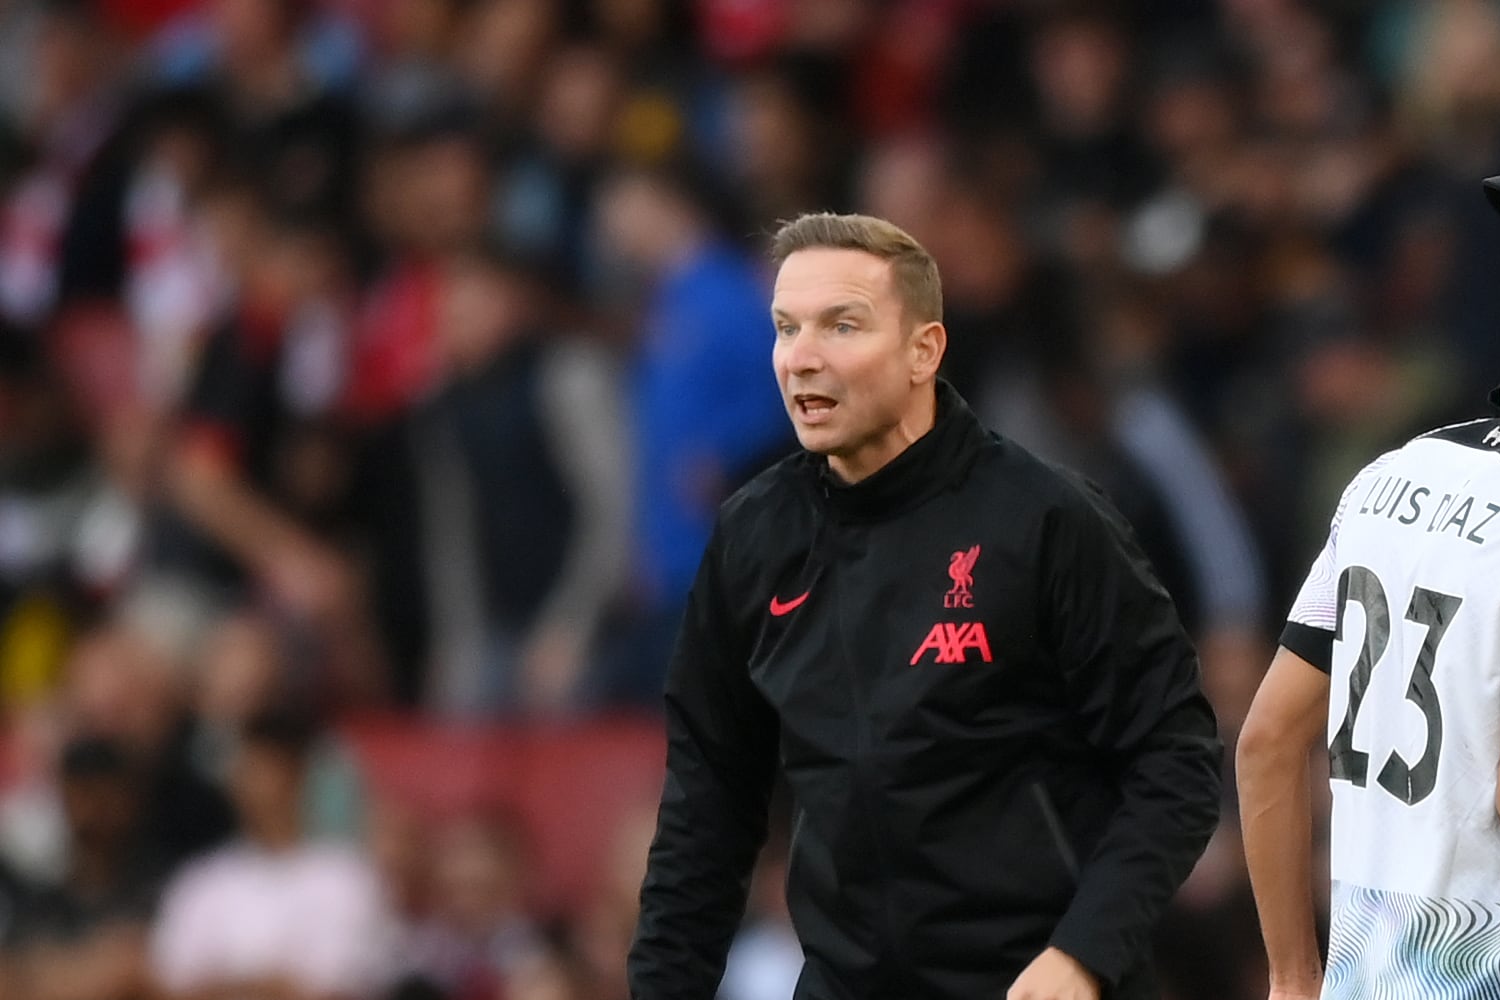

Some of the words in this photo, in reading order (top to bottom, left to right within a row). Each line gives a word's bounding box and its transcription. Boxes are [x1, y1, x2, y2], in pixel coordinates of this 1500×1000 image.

[1359, 475, 1431, 526] LUIS
[943, 594, 975, 608] LFC
[909, 622, 993, 666] AXA
[1329, 565, 1464, 806] 23
